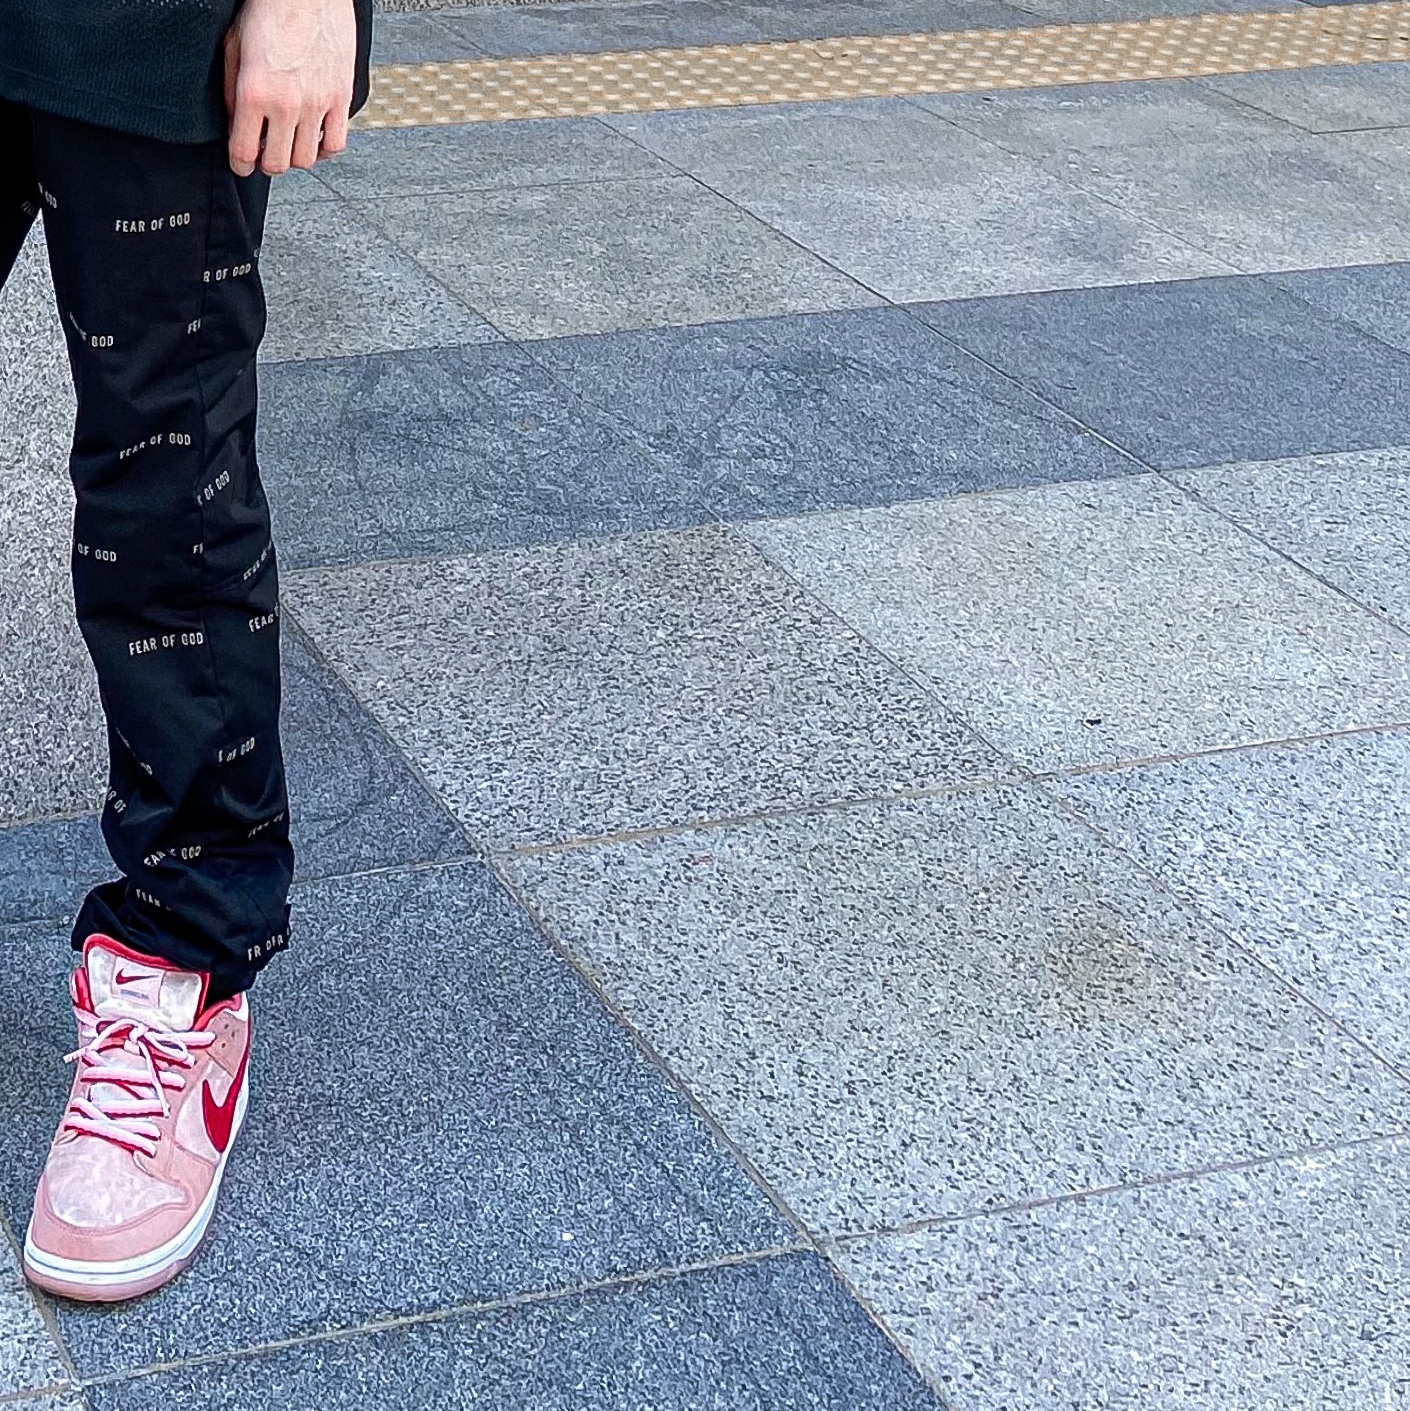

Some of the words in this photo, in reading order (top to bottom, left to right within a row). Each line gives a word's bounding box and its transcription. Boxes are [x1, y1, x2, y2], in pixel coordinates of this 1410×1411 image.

[115, 219, 145, 233] FEAR
[151, 218, 164, 231] OF
[170, 212, 190, 228] GOD
[216, 269, 228, 281] OF
[233, 263, 251, 277] GOD
[91, 335, 114, 347] GOD
[119, 441, 145, 460] FEAR
[150, 434, 163, 445] OF
[169, 433, 191, 446] GOD
[77, 542, 90, 556] OF
[95, 549, 117, 562] GOD
[128, 638, 158, 656] FEAR
[162, 634, 176, 647] OF
[181, 632, 204, 646] GOD
